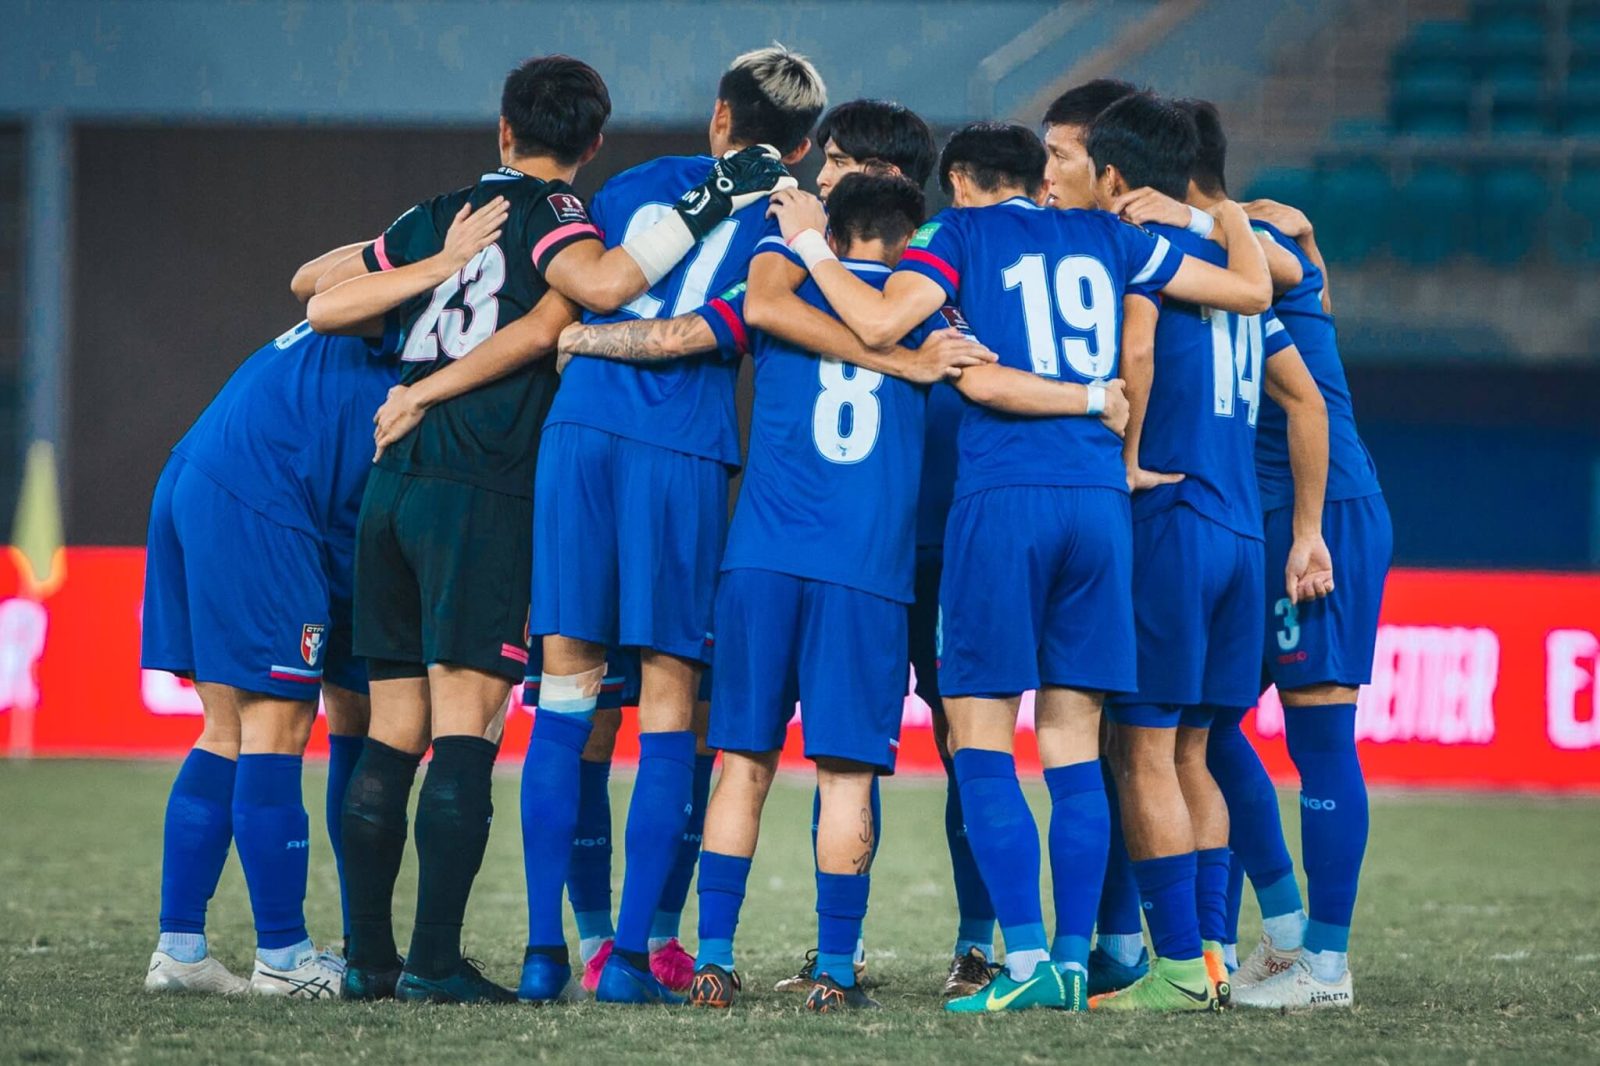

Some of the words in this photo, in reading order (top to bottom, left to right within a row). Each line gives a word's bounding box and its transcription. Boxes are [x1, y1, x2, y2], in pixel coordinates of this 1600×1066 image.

[400, 242, 506, 361] 23
[1001, 253, 1117, 379] 19
[811, 358, 885, 465] 8
[1201, 304, 1263, 428] 14
[1274, 597, 1300, 650] 3
[1310, 992, 1349, 1004] ATHLETA
